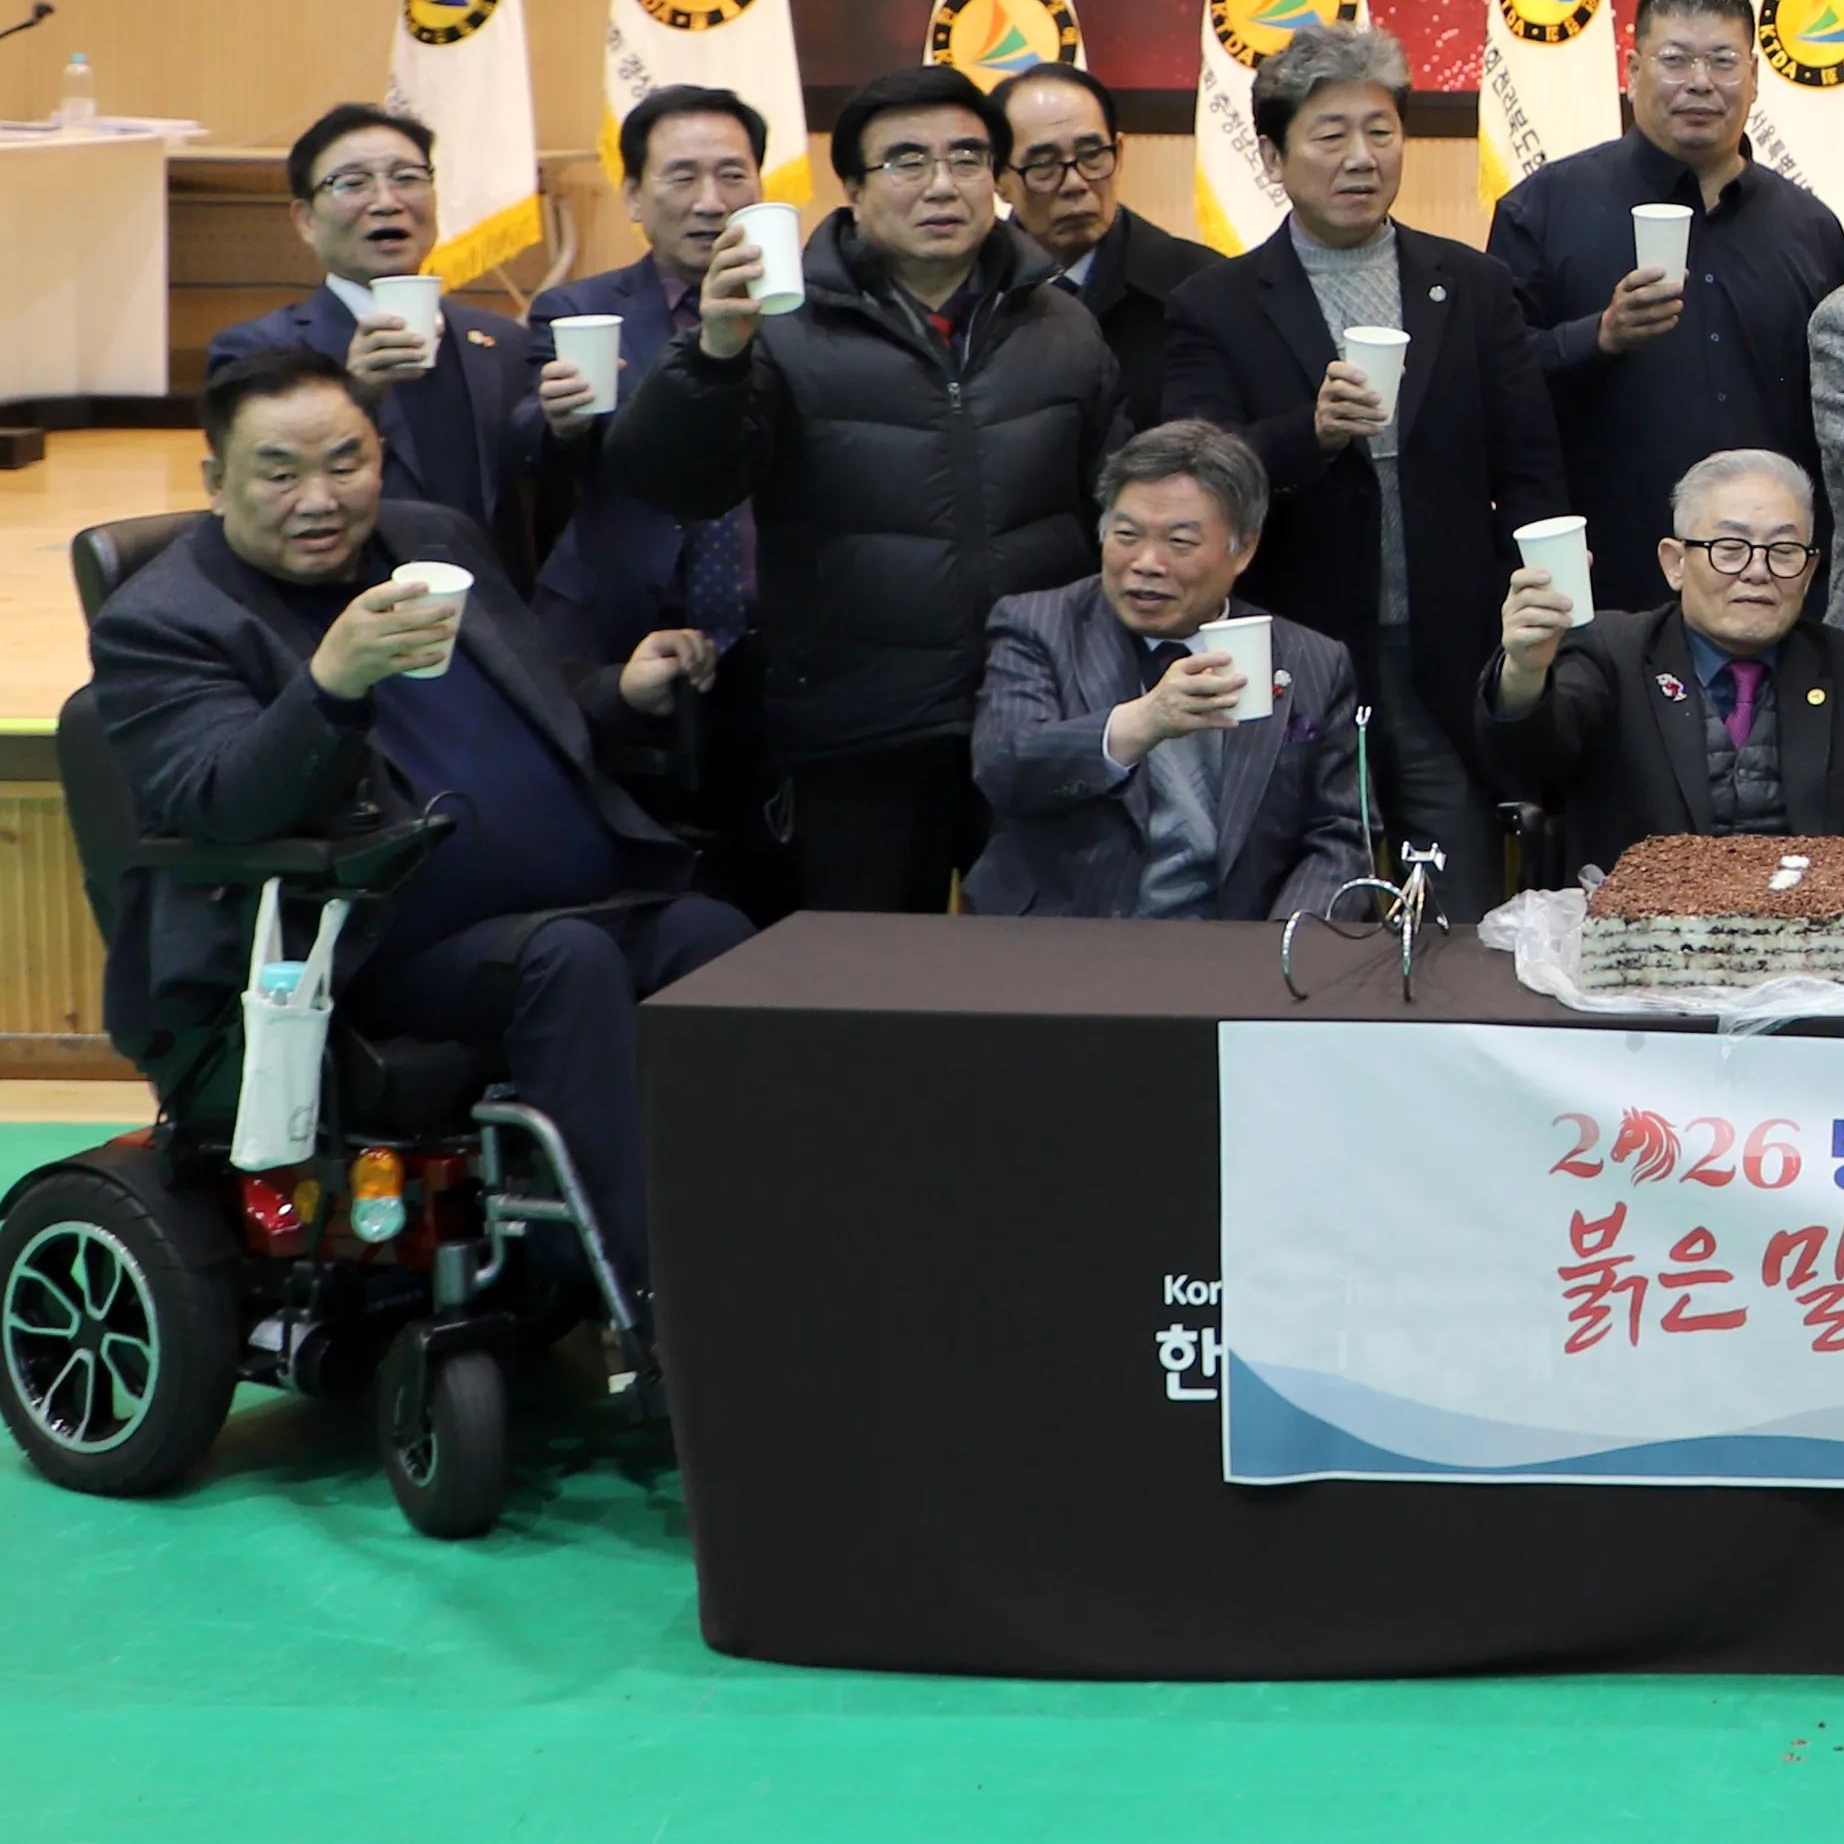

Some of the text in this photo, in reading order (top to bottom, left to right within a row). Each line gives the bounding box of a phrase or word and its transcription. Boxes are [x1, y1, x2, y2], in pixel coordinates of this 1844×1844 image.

[1758, 25, 1798, 81] KTDA
[1163, 1273, 1223, 1306] Kor
[1556, 1201, 1749, 1355] 붉은
